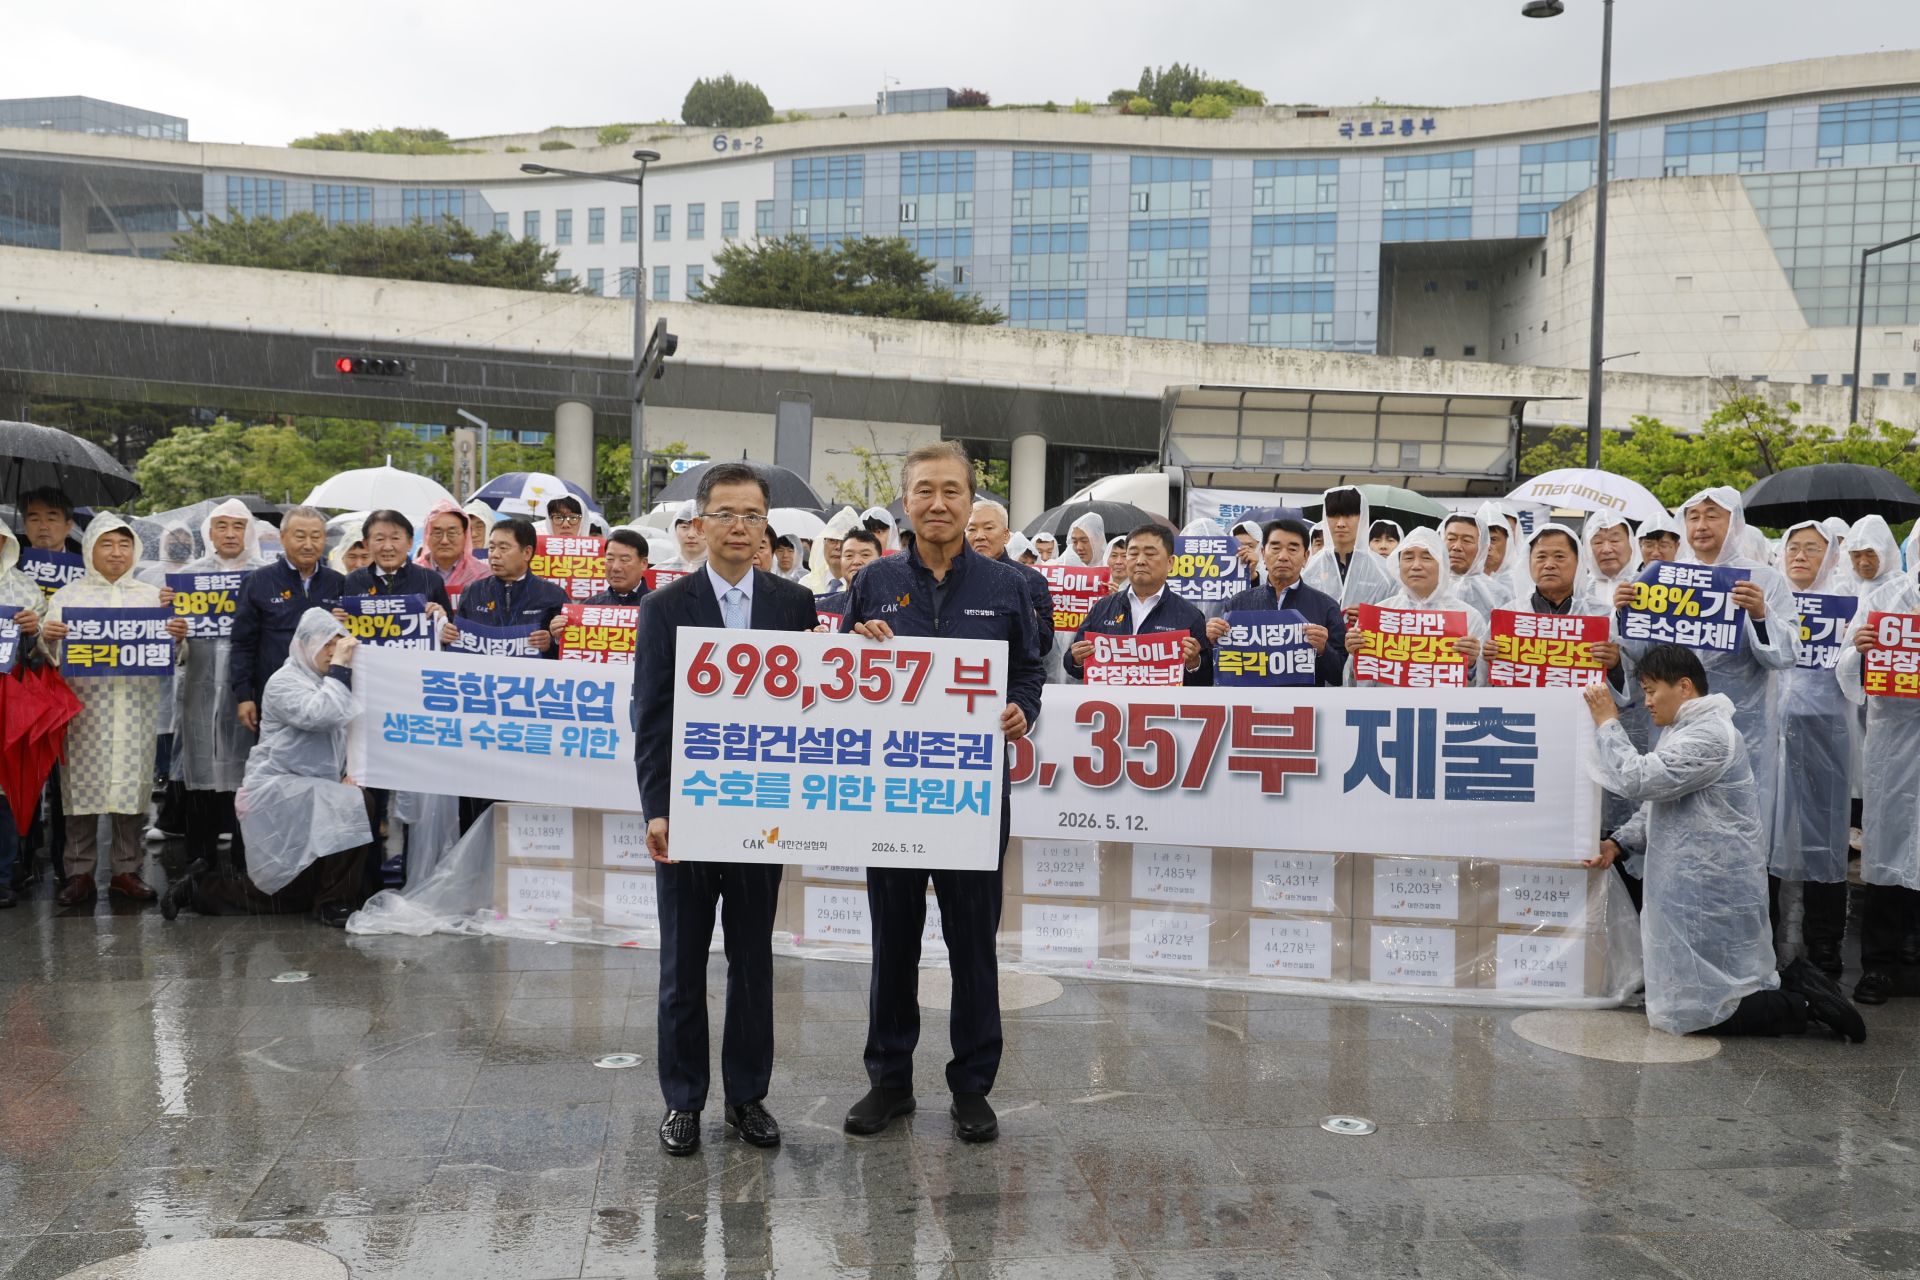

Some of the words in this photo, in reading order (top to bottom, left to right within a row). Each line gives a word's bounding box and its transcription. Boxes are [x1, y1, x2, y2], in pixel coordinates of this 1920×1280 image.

[1338, 117, 1436, 140] 국토교통부
[1530, 483, 1628, 512] maruman
[545, 537, 601, 556] 종합만
[1184, 539, 1227, 554] 종합도
[194, 575, 242, 591] 종합도
[1658, 565, 1713, 588] 종합도
[172, 591, 239, 616] 98%
[360, 599, 406, 614] 종합도
[881, 603, 898, 613] CAK
[1628, 581, 1741, 621] 98%가
[581, 607, 638, 628] 종합만
[1379, 610, 1445, 636] 종합만
[1514, 614, 1584, 641] 종합만
[1625, 612, 1737, 650] 중소업체!
[1094, 636, 1181, 663] 6년이나
[1359, 630, 1464, 663] 희생강요
[1493, 635, 1604, 668] 희생강요
[686, 641, 933, 712] 698,357
[944, 656, 997, 714] 부
[1356, 655, 1403, 685] 즉각
[1490, 660, 1540, 688] 즉각
[1865, 672, 1888, 692] 또
[1894, 673, 1920, 694] 연
[420, 669, 615, 724] 종합건설업
[383, 711, 463, 748] 생존권
[470, 720, 553, 756] 수호를
[560, 726, 620, 760] 위한
[683, 722, 872, 767] 종합건설업
[882, 729, 994, 771] 생존권
[1342, 706, 1539, 803] 제출
[681, 770, 792, 809] 수호를
[801, 773, 876, 812] 위한
[884, 777, 991, 816] 탄원서
[742, 838, 765, 850] CAK
[777, 839, 828, 851] 대한건설협회
[1036, 861, 1085, 873] 23,922부
[1147, 866, 1197, 880] 17,485부
[1267, 874, 1320, 887] 35,431부
[1390, 882, 1442, 895] 16,203부
[1514, 888, 1571, 903] 99,248부
[816, 908, 863, 922] 29,961부
[1264, 941, 1317, 955] 44,278부
